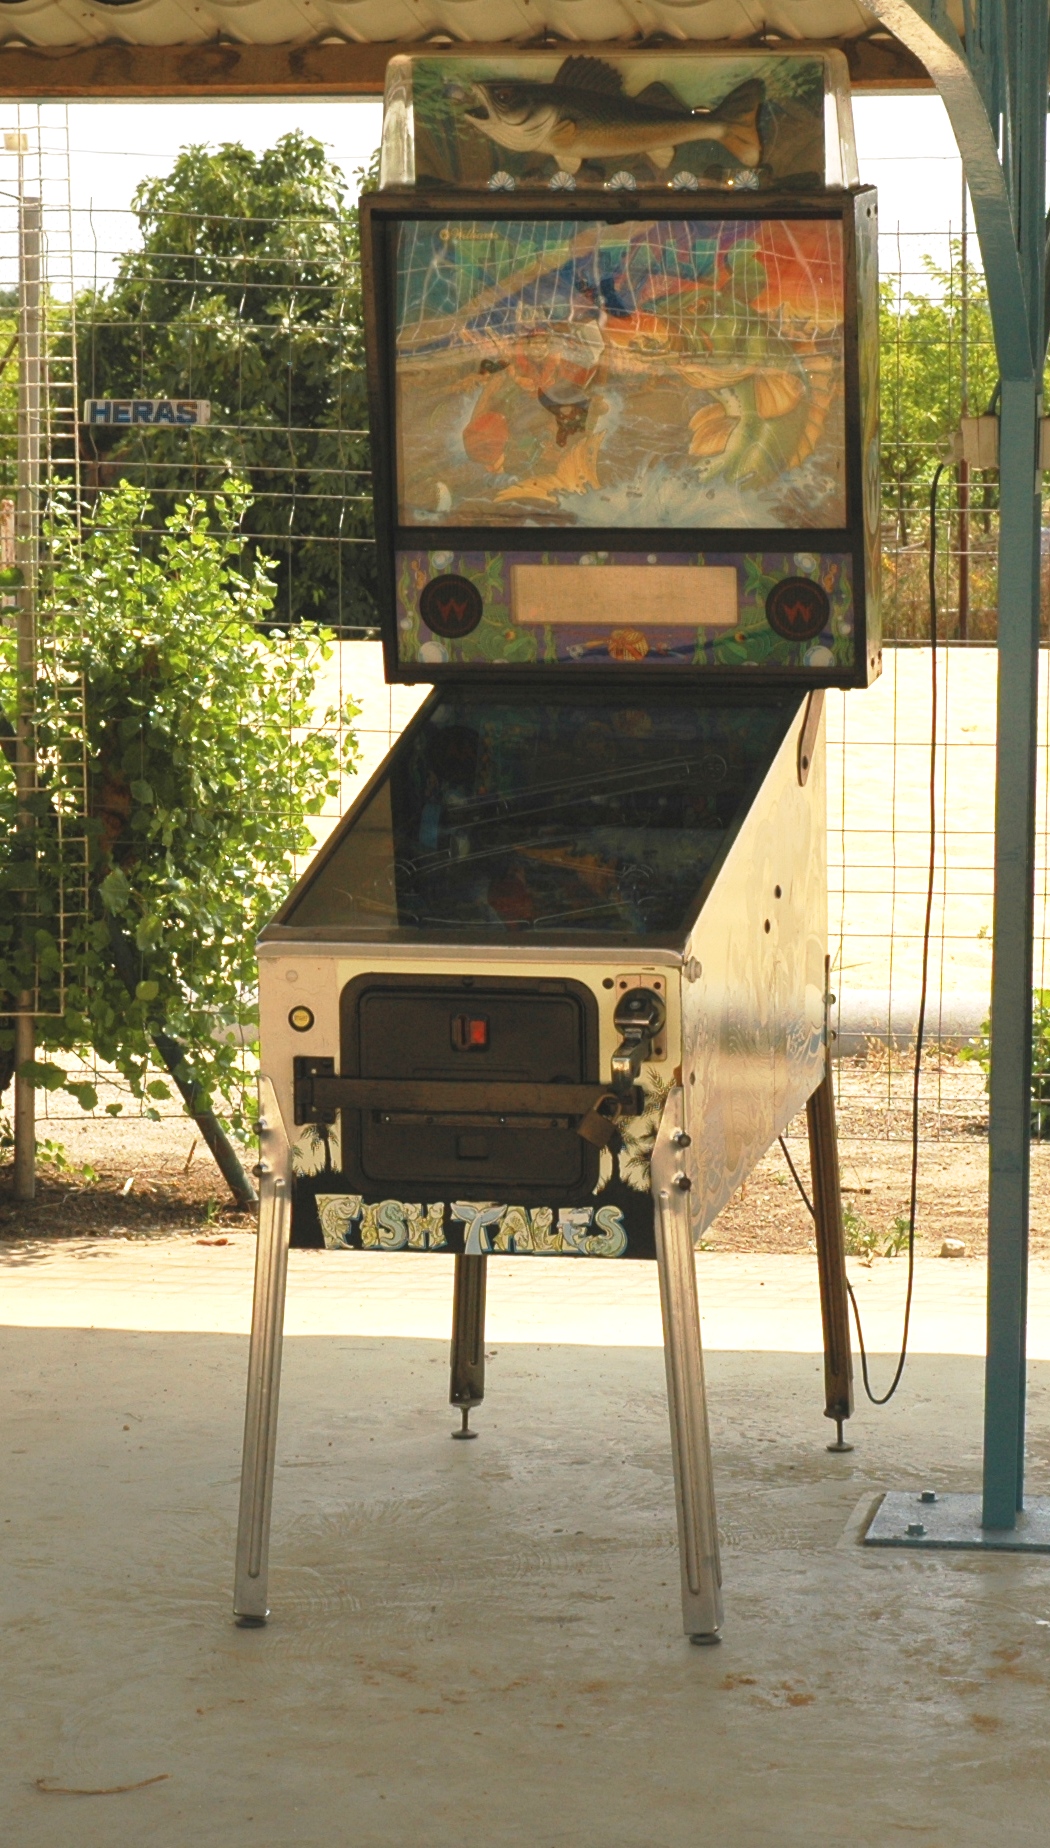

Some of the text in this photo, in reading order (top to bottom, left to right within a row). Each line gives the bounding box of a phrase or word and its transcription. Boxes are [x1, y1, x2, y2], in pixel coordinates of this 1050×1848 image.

[90, 401, 198, 423] HERAS
[315, 1194, 628, 1257] FISH TALES
